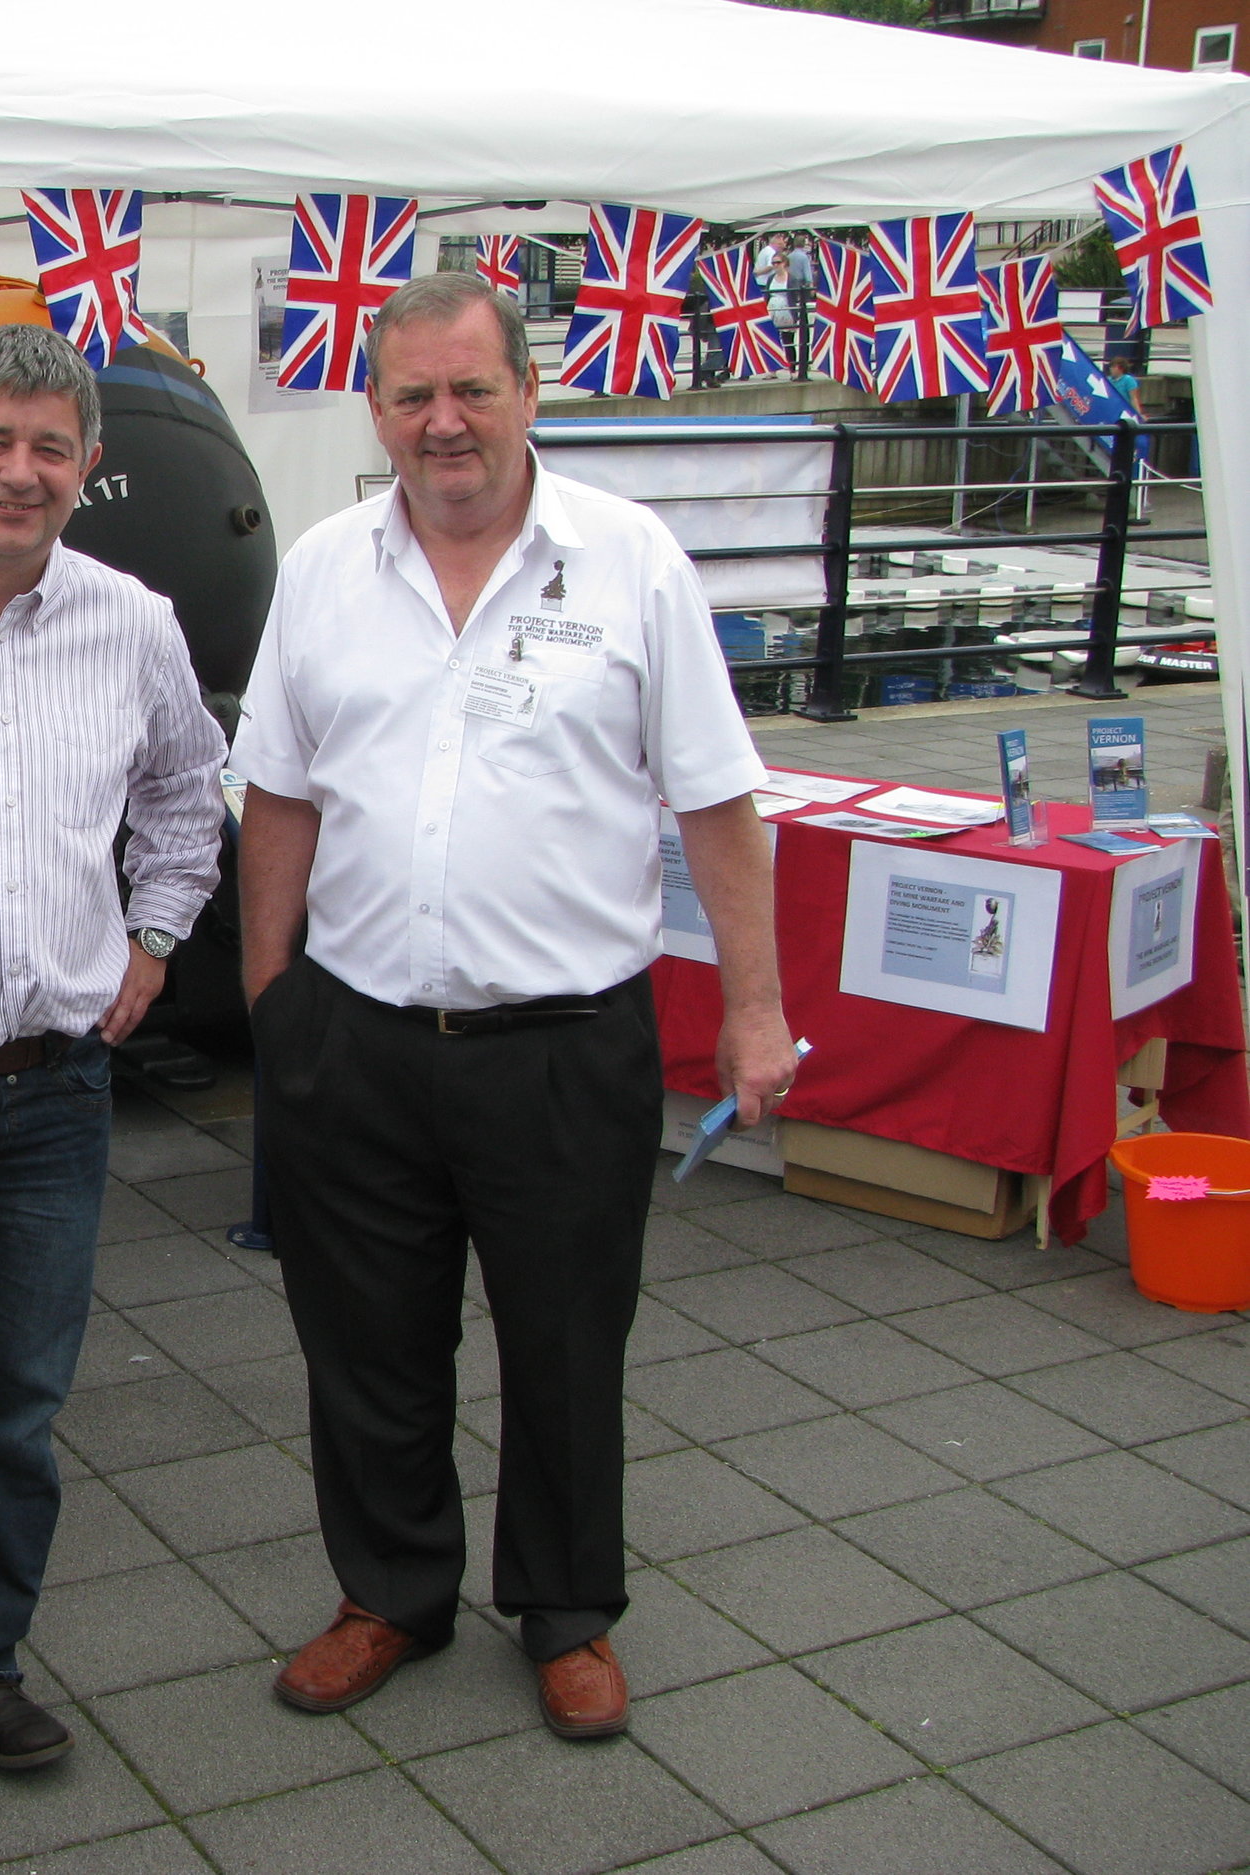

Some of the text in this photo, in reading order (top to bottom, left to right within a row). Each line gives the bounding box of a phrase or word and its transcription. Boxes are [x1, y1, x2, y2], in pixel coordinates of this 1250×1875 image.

[94, 474, 129, 500] 17
[509, 615, 604, 636] PROJECT VERNON
[525, 626, 548, 635] MINE
[548, 629, 583, 639] WARFARE
[585, 635, 603, 643] AND
[546, 635, 594, 648] MONUMENT
[1159, 657, 1213, 670] MASTER
[1091, 734, 1137, 744] VERNON
[911, 903, 951, 913] MONUMENT
